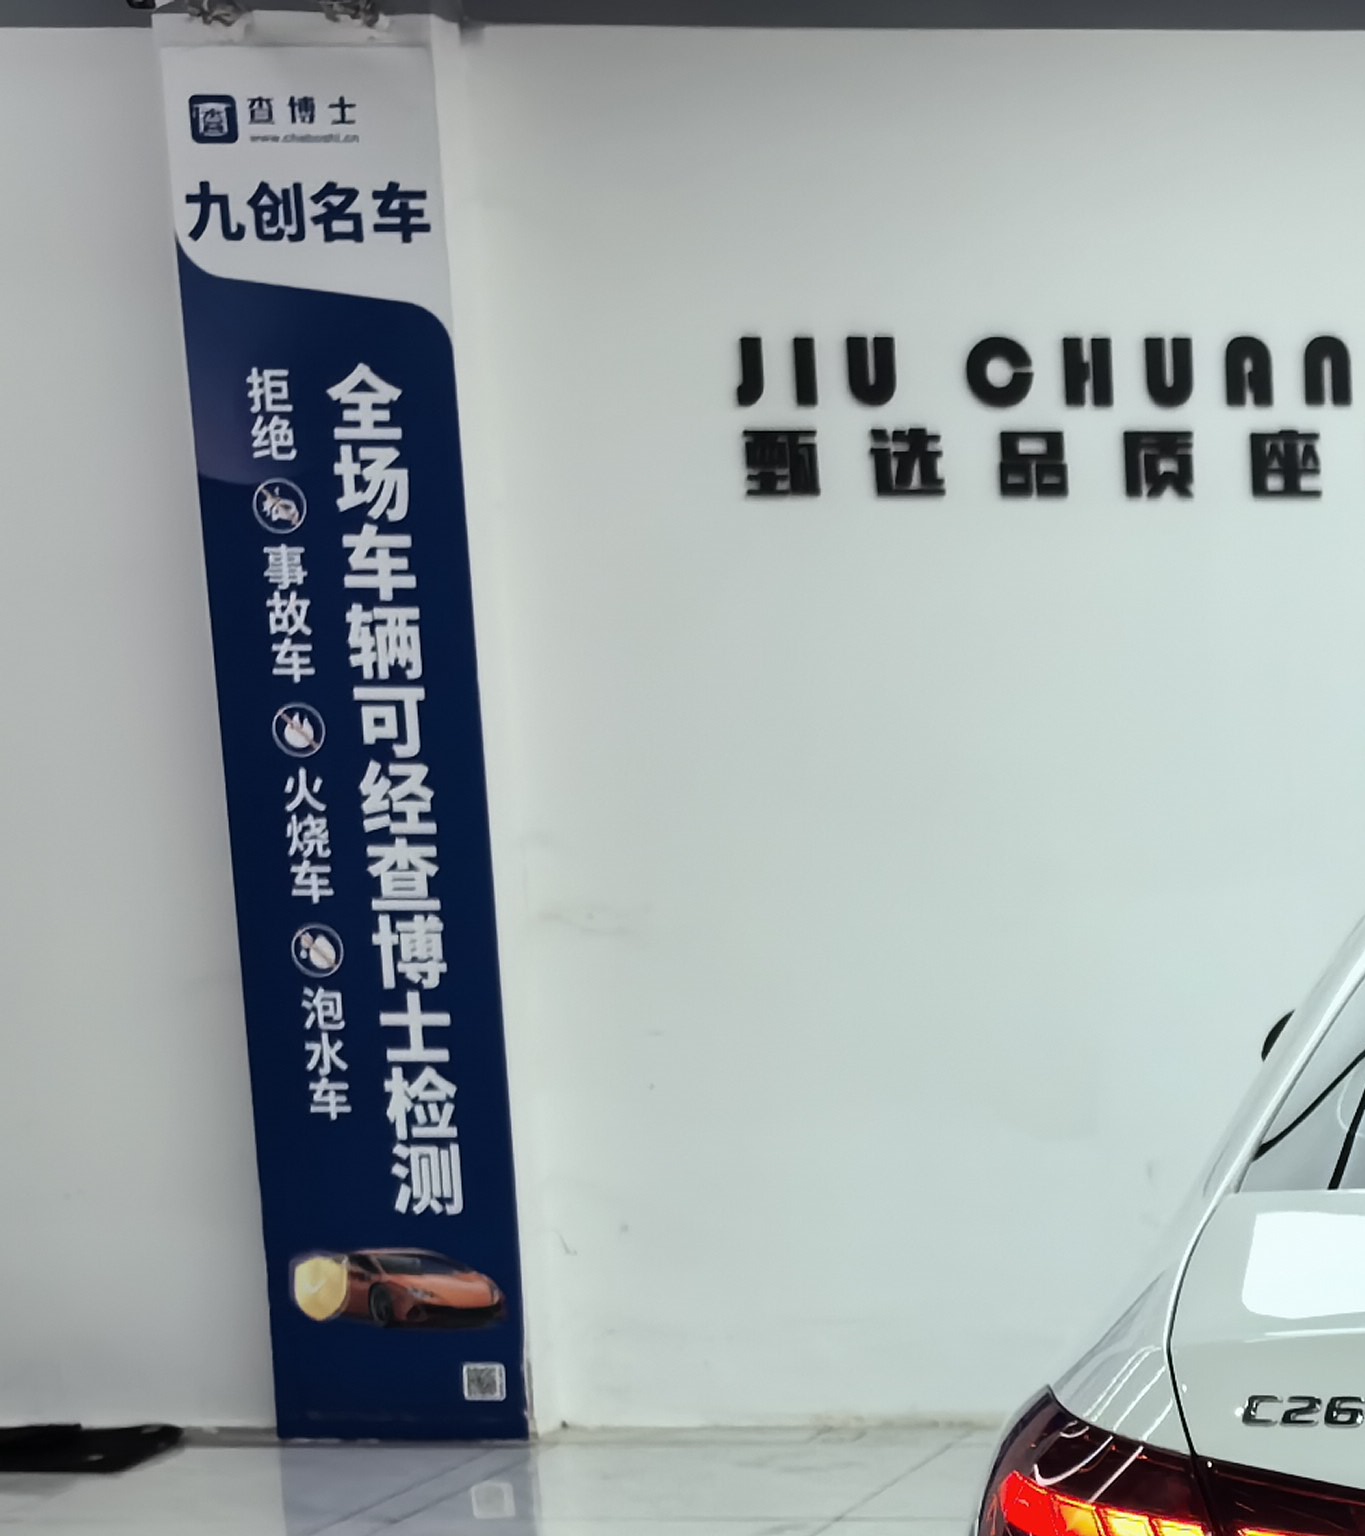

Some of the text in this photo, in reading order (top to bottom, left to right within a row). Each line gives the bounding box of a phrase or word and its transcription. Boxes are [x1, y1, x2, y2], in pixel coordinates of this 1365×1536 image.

[248, 95, 357, 125] 查博士
[184, 181, 431, 244] 九创名车
[736, 335, 897, 408] JIU
[246, 367, 352, 1121] 拒绝 事故车 火烧车 泡水车
[326, 362, 465, 1216] 全场车辆可经查博士检测
